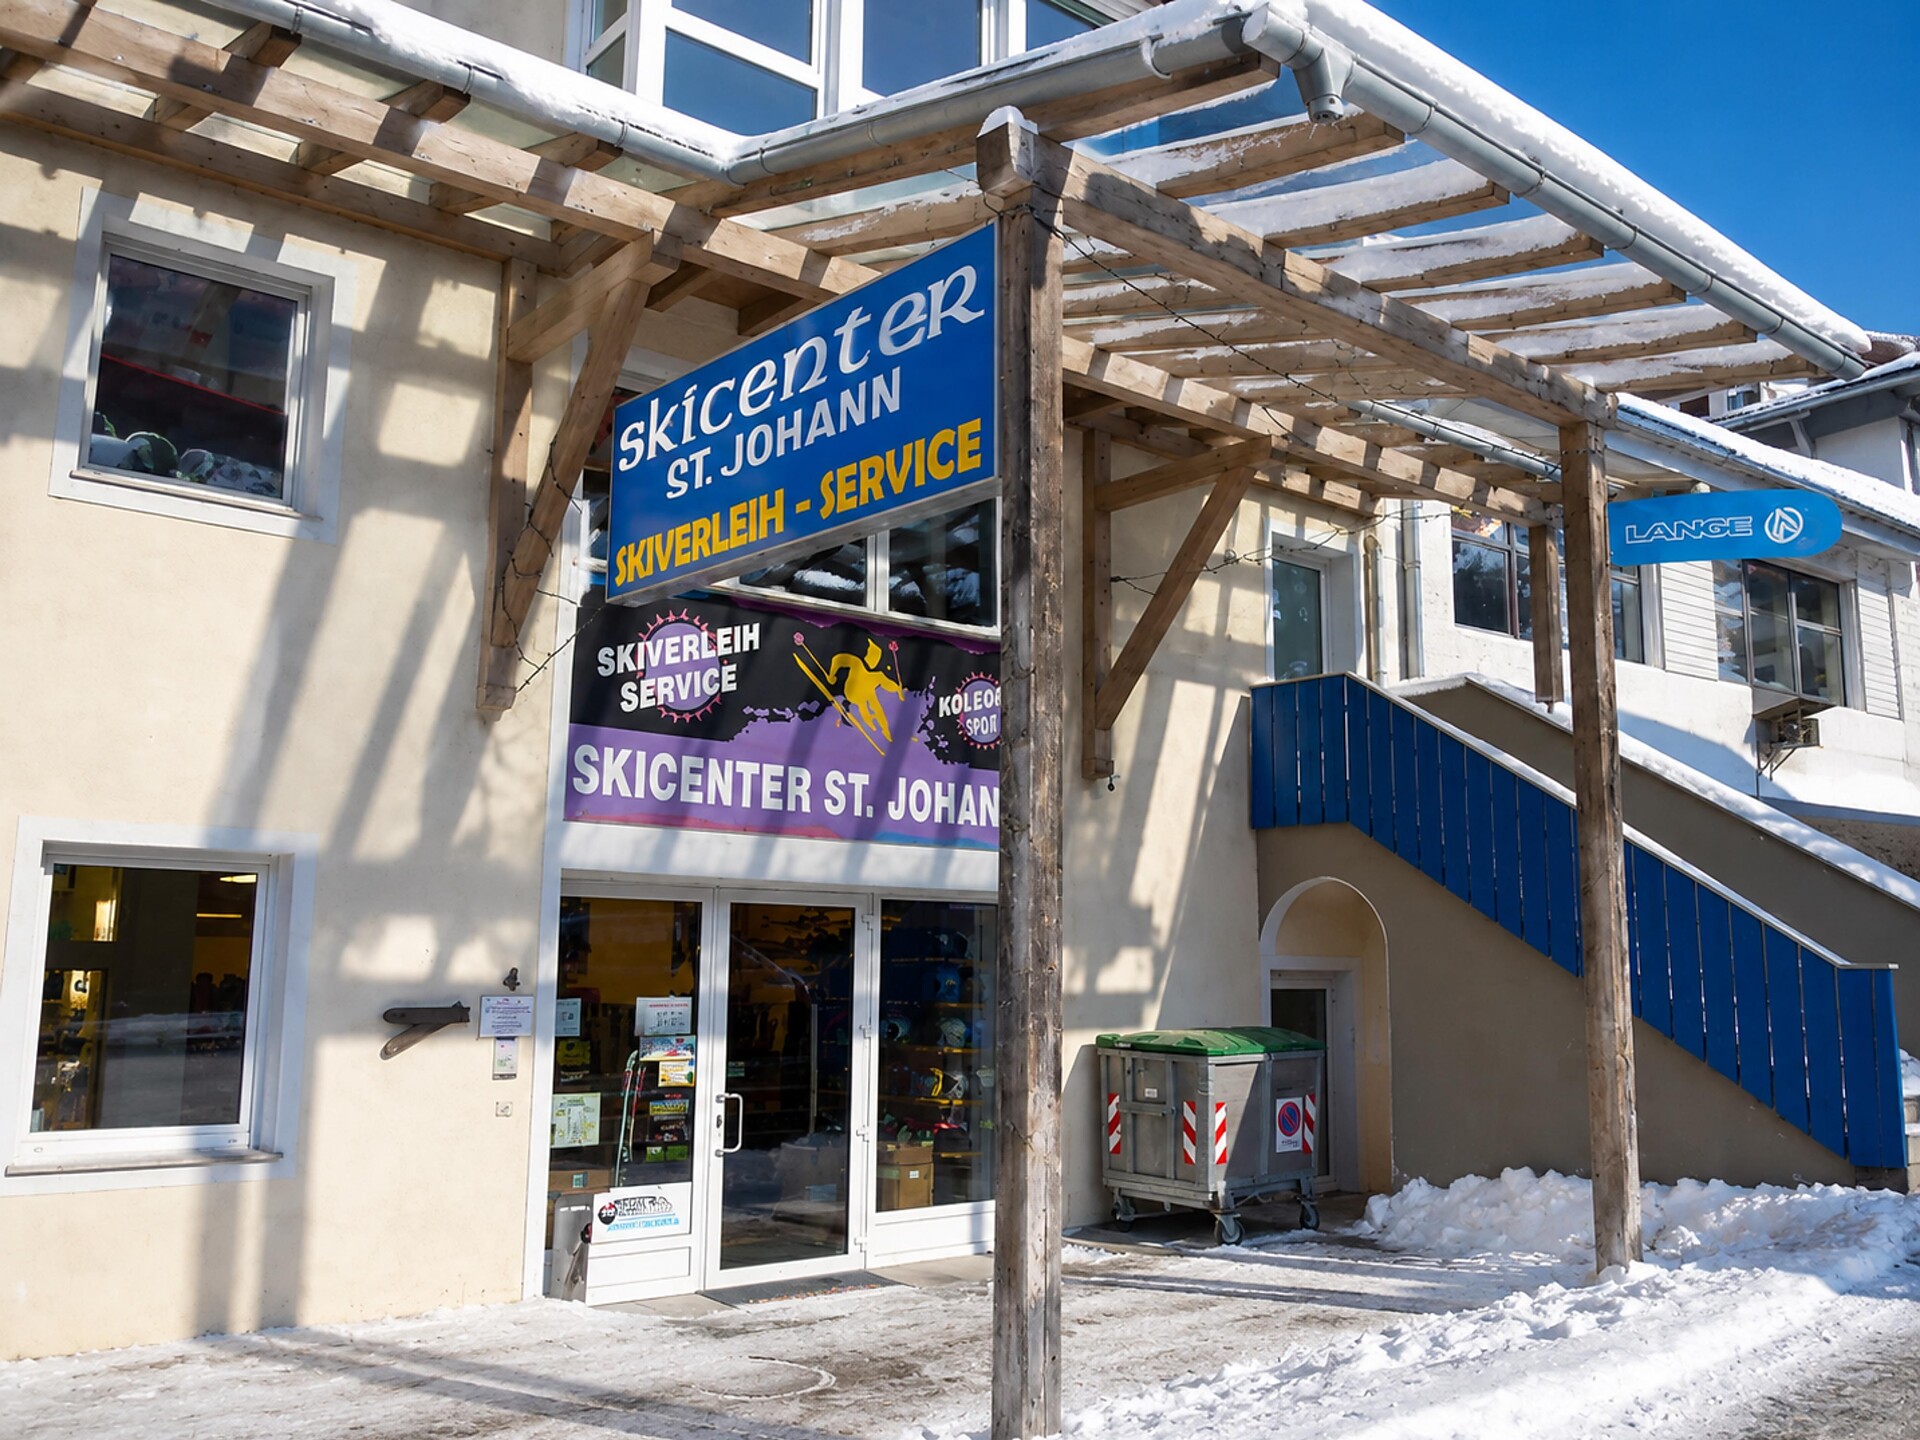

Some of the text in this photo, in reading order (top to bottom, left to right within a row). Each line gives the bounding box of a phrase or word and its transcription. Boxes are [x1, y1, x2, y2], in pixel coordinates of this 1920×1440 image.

[666, 367, 900, 499] ST. JOHANN
[615, 488, 785, 587] SKIVERLEIH
[819, 417, 982, 520] SERVICE
[1625, 516, 1754, 544] LANGE
[597, 623, 761, 677] SKIVERLEIH
[620, 664, 737, 712] SERVICE
[573, 745, 1000, 828] SKICENTER ST. JOHAN
